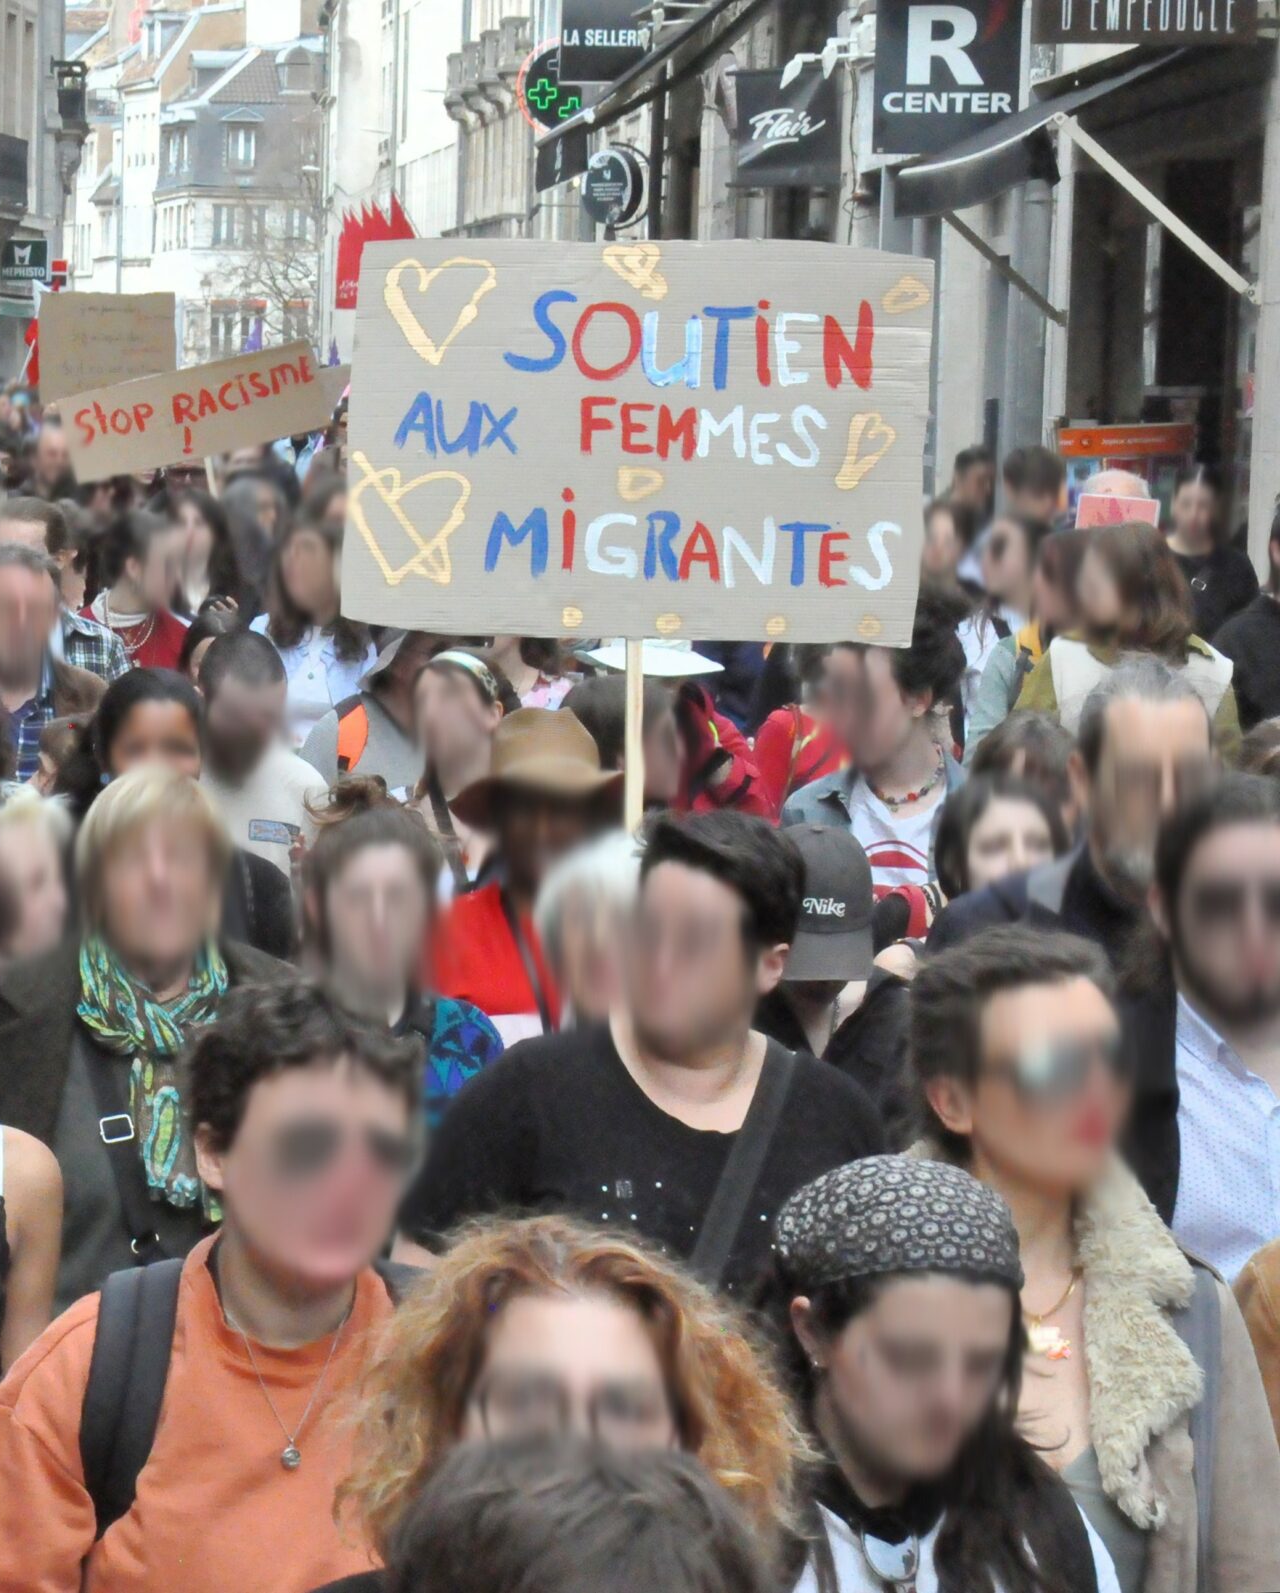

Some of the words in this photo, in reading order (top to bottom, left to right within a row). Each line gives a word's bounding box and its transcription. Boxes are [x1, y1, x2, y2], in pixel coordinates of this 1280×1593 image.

[563, 29, 580, 46] LA
[882, 92, 1012, 113] CENTER
[749, 108, 826, 140] Flair
[2, 266, 46, 278] MEPHISTO
[183, 426, 193, 454] !
[394, 392, 519, 459] AUX
[579, 396, 828, 468] FEMMES
[802, 897, 846, 918] Nike
